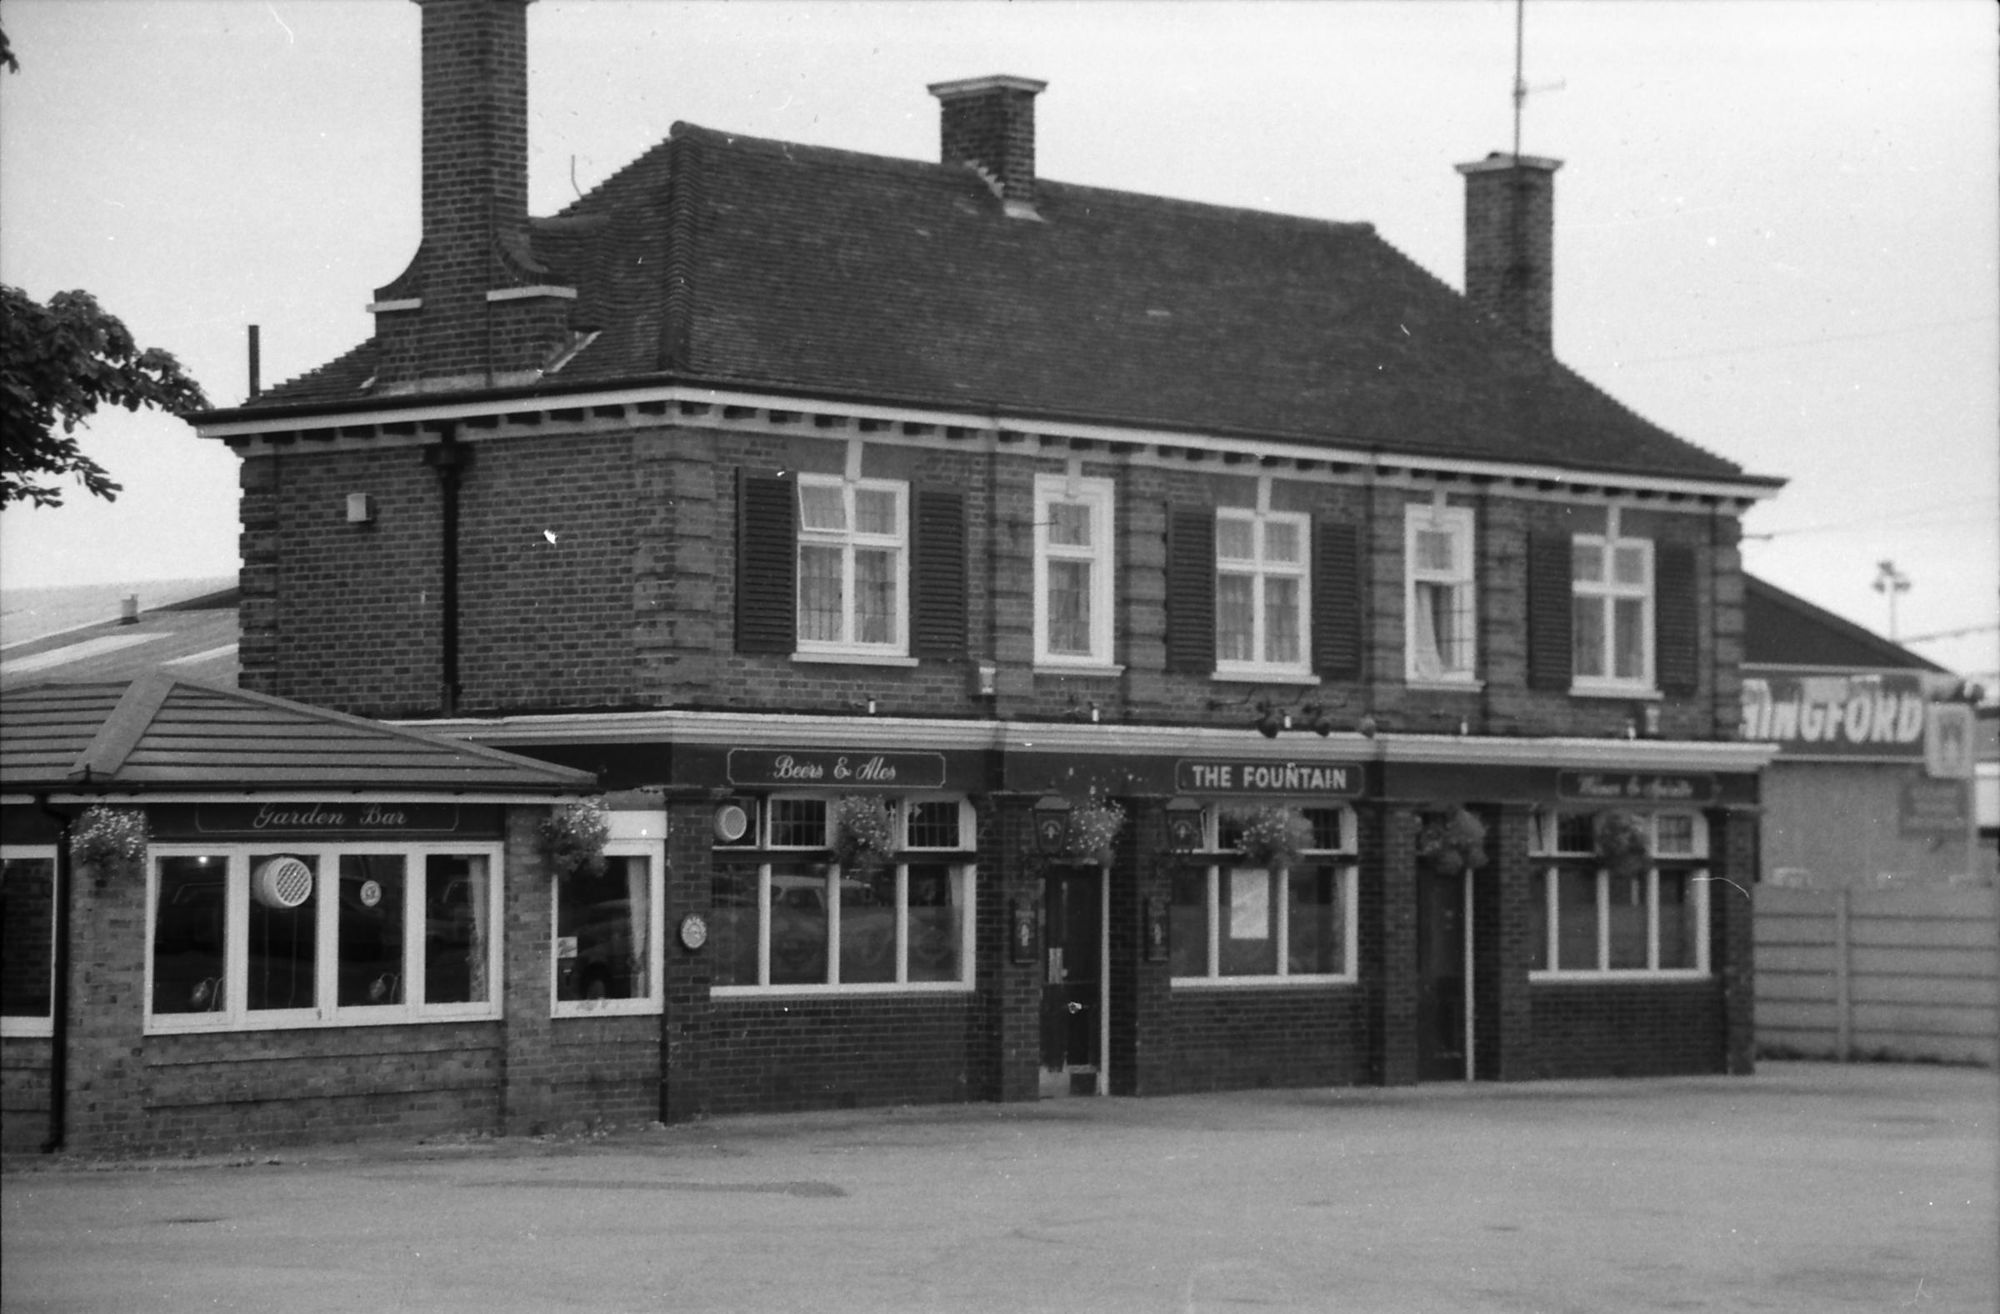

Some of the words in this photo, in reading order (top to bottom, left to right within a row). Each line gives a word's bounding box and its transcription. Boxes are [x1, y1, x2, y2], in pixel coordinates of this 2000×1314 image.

[773, 754, 823, 779] Beers
[833, 756, 850, 779] &
[856, 756, 896, 780] Ales
[1192, 765, 1231, 788] THE
[1243, 766, 1347, 789] FOUNTAIN
[253, 802, 346, 829] Garden
[360, 802, 407, 825] Bar
